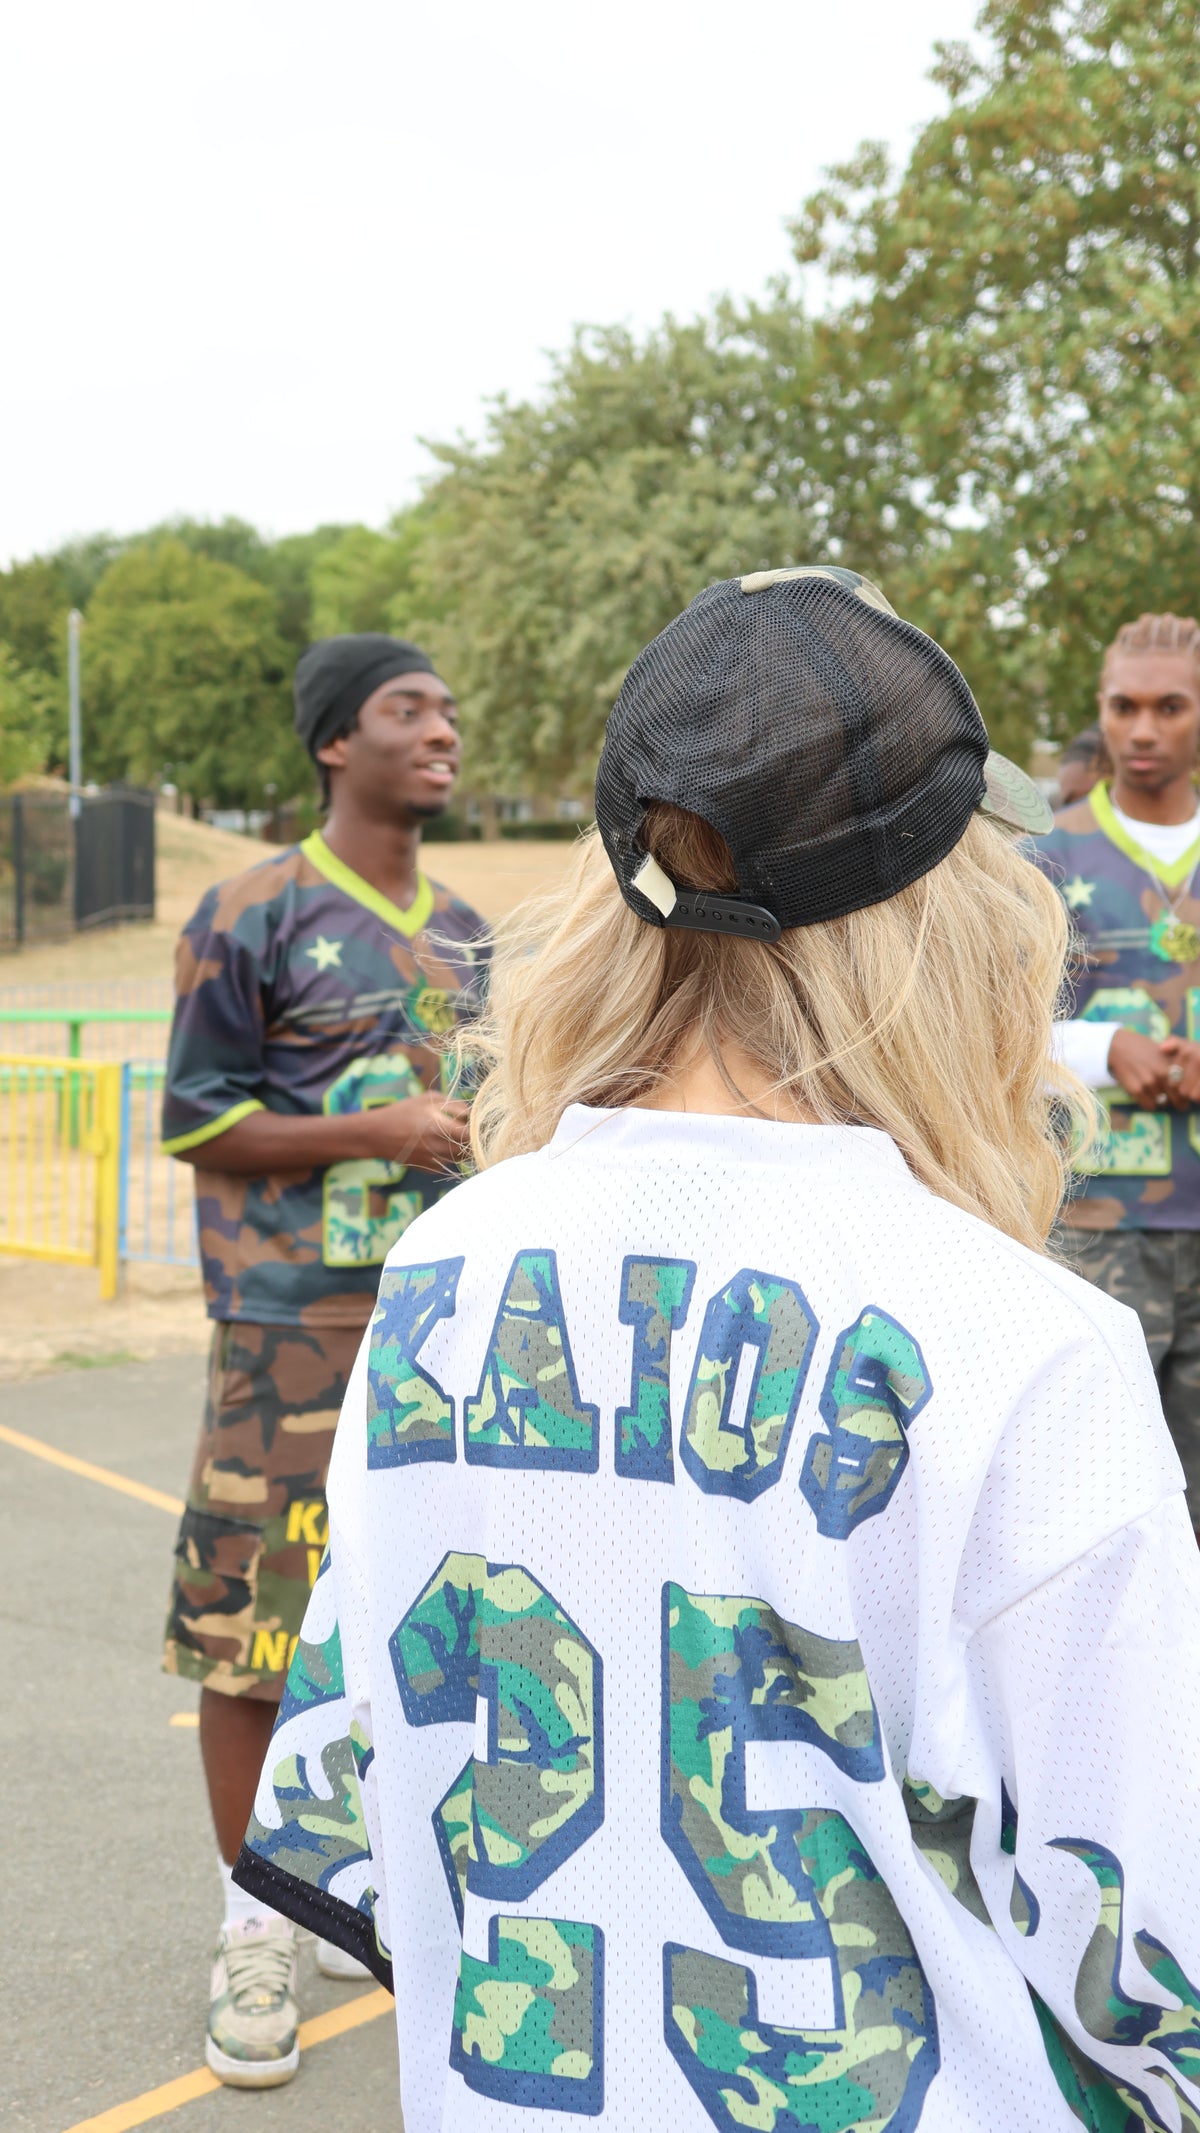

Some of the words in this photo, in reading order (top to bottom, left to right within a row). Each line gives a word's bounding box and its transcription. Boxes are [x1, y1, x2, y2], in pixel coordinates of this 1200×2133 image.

[285, 1501, 330, 1544] K
[366, 1249, 934, 1540] KAIOS
[388, 1550, 941, 2133] 25
